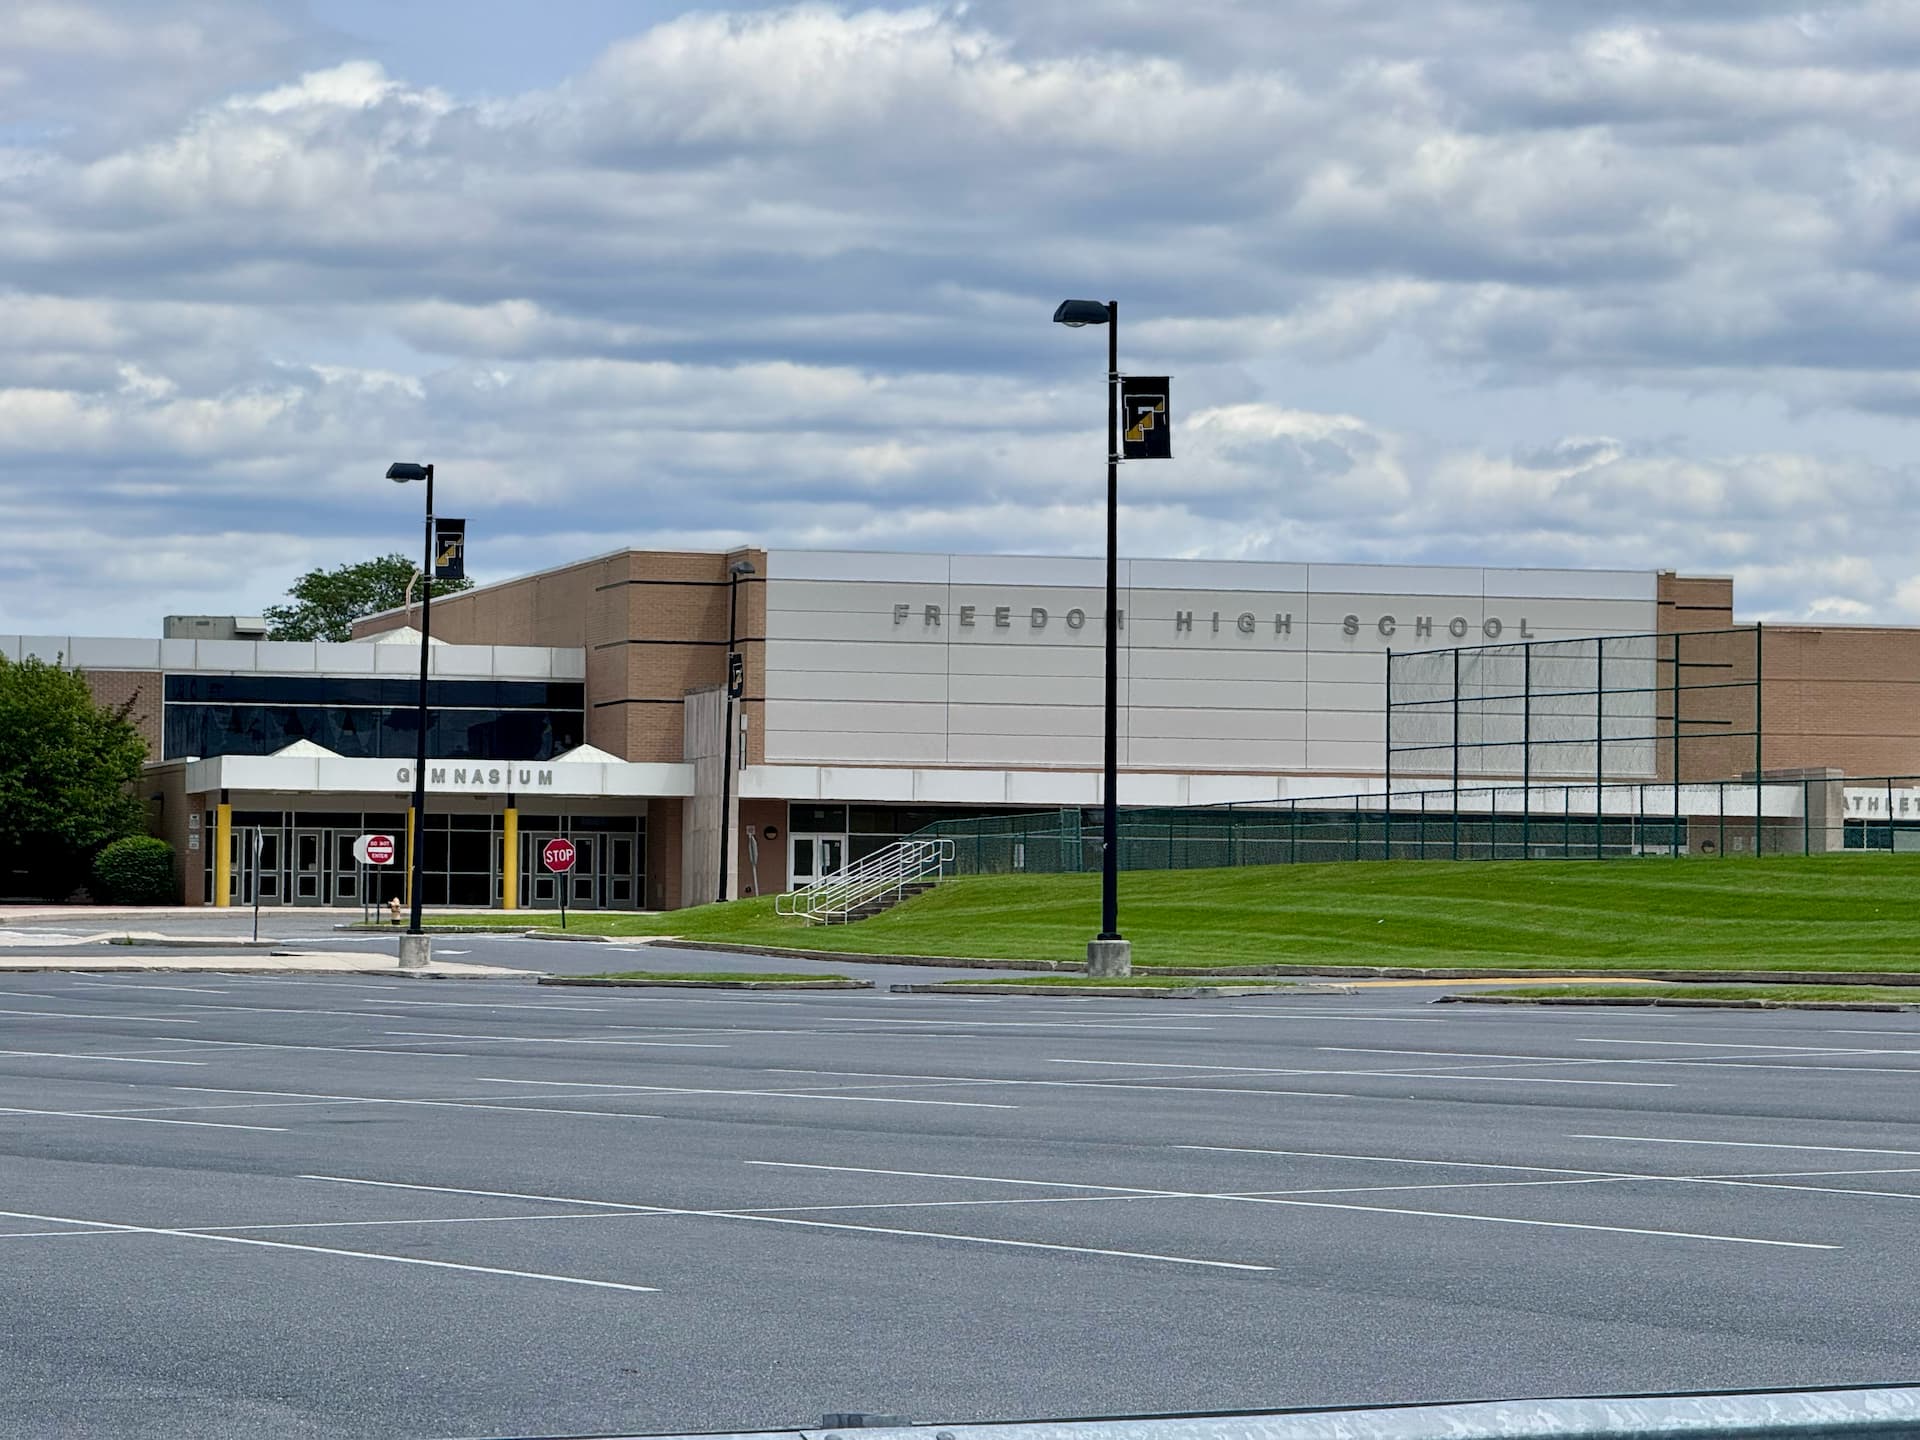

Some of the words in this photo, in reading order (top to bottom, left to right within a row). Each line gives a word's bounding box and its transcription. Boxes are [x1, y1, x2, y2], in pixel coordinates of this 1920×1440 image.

[894, 604, 1124, 630] FREEDO
[1176, 611, 1292, 634] HIGH
[1343, 615, 1534, 638] SCHOOL
[397, 768, 553, 786] GMNASIUM
[546, 849, 573, 863] STOP
